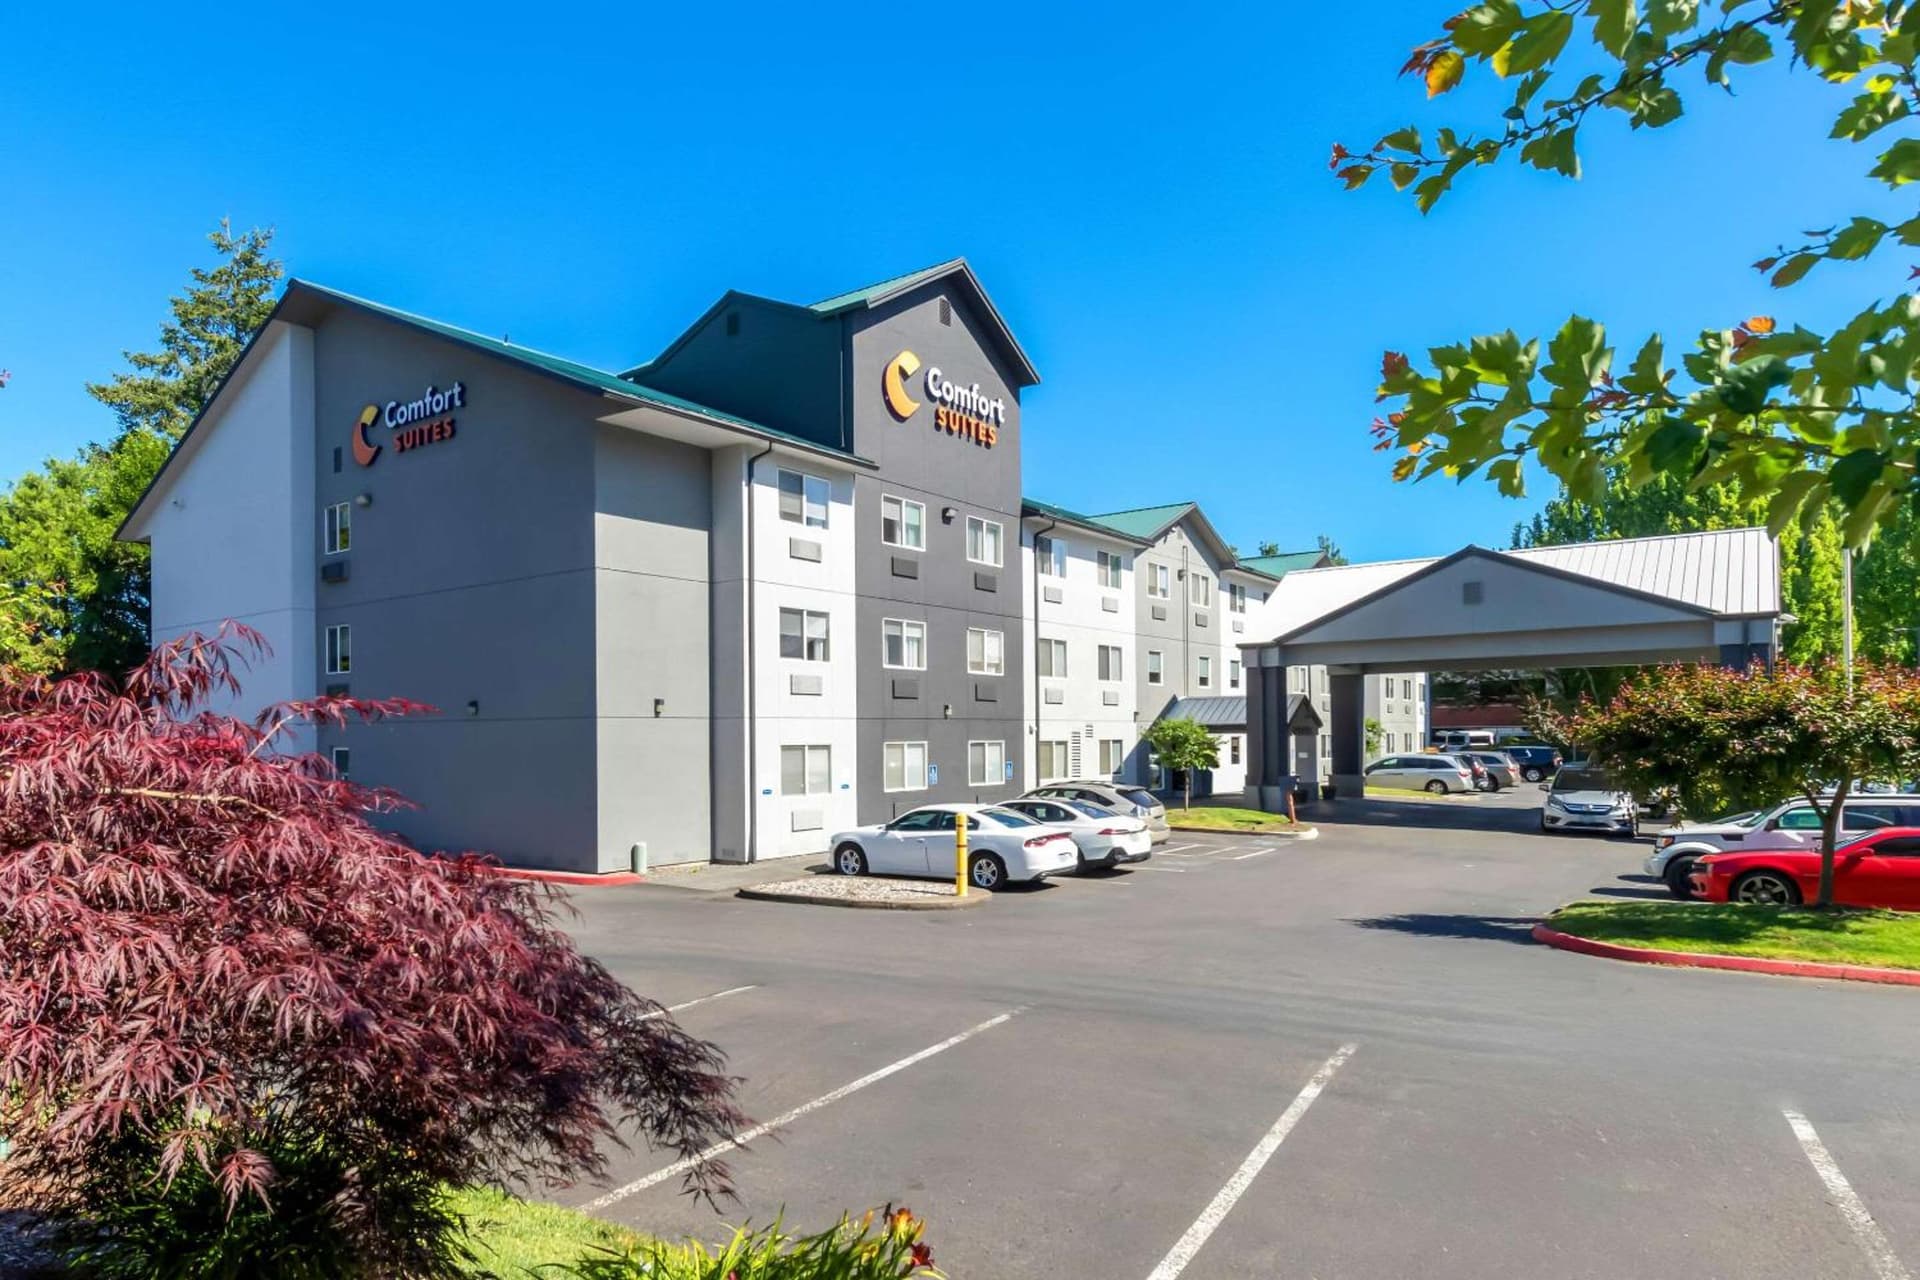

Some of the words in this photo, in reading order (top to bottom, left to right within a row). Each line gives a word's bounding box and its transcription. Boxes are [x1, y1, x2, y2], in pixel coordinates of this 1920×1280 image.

[384, 381, 462, 428] Comfort
[926, 367, 1005, 424] Comfort
[393, 417, 454, 453] SUITES
[936, 406, 997, 446] SUITES
